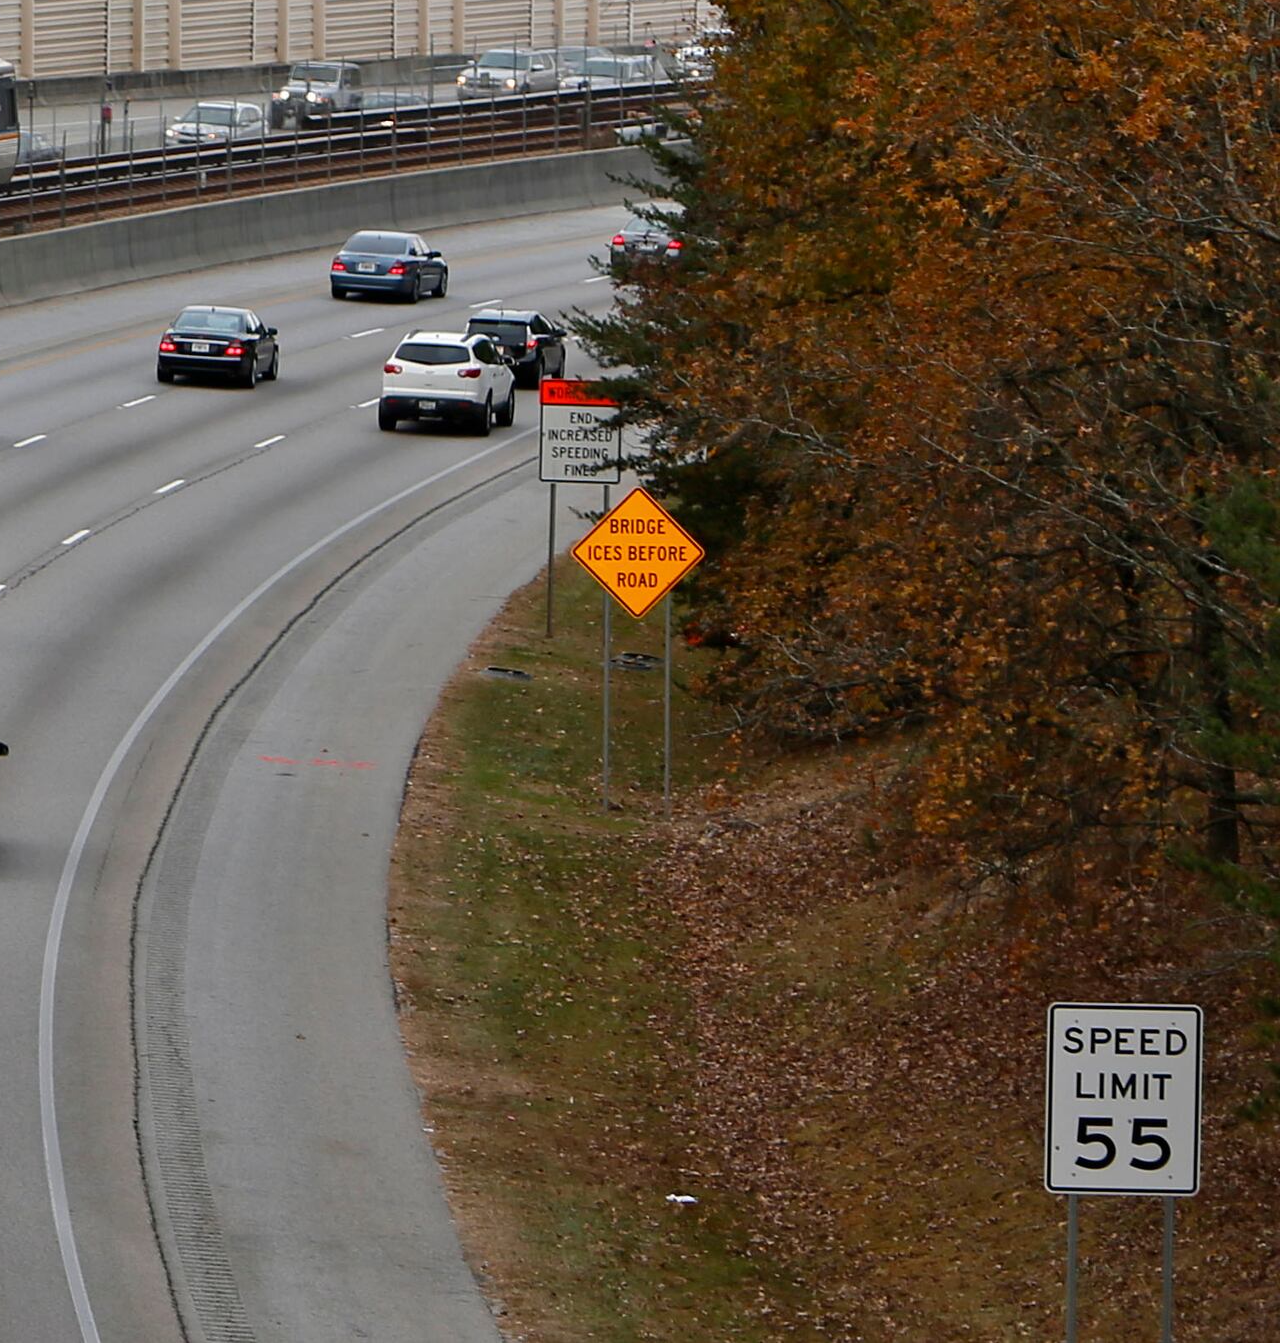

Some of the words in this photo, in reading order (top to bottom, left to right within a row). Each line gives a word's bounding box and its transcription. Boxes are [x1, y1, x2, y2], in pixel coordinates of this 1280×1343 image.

[570, 412, 592, 424] END
[548, 430, 613, 442] INCREASED
[551, 446, 609, 459] SPEEDING
[564, 464, 598, 477] FINES
[610, 519, 666, 534] BRIDGE
[588, 545, 622, 561] ICES
[628, 546, 688, 561] BEFORE
[617, 572, 658, 588] ROAD
[1063, 1027, 1188, 1056] SPEED
[1076, 1072, 1172, 1101] LIMIT
[1074, 1117, 1171, 1171] 55
